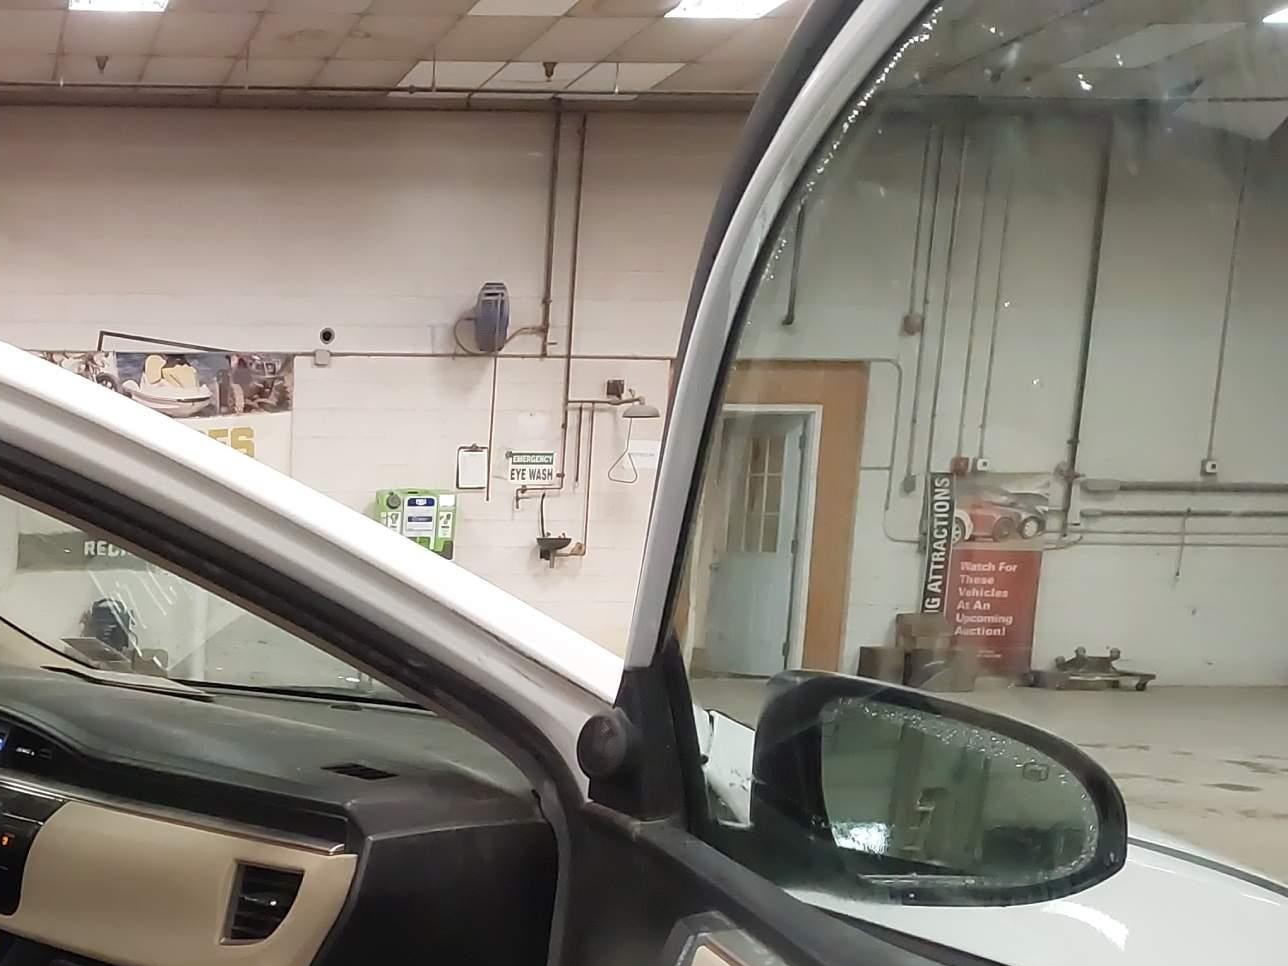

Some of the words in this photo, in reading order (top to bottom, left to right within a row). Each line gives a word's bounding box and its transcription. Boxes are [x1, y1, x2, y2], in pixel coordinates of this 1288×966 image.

[512, 454, 553, 464] EMERGENCY
[510, 468, 526, 481] EYE
[528, 468, 553, 481] WASH
[927, 477, 951, 593] ATTRACTIONS
[960, 561, 995, 572] Watch
[998, 562, 1018, 572] For
[959, 574, 995, 585] These
[958, 587, 1009, 598] Vehicles
[956, 600, 970, 610] At
[972, 600, 991, 610] An
[955, 613, 1014, 626] Upcoming
[954, 626, 1006, 636] Auction!
